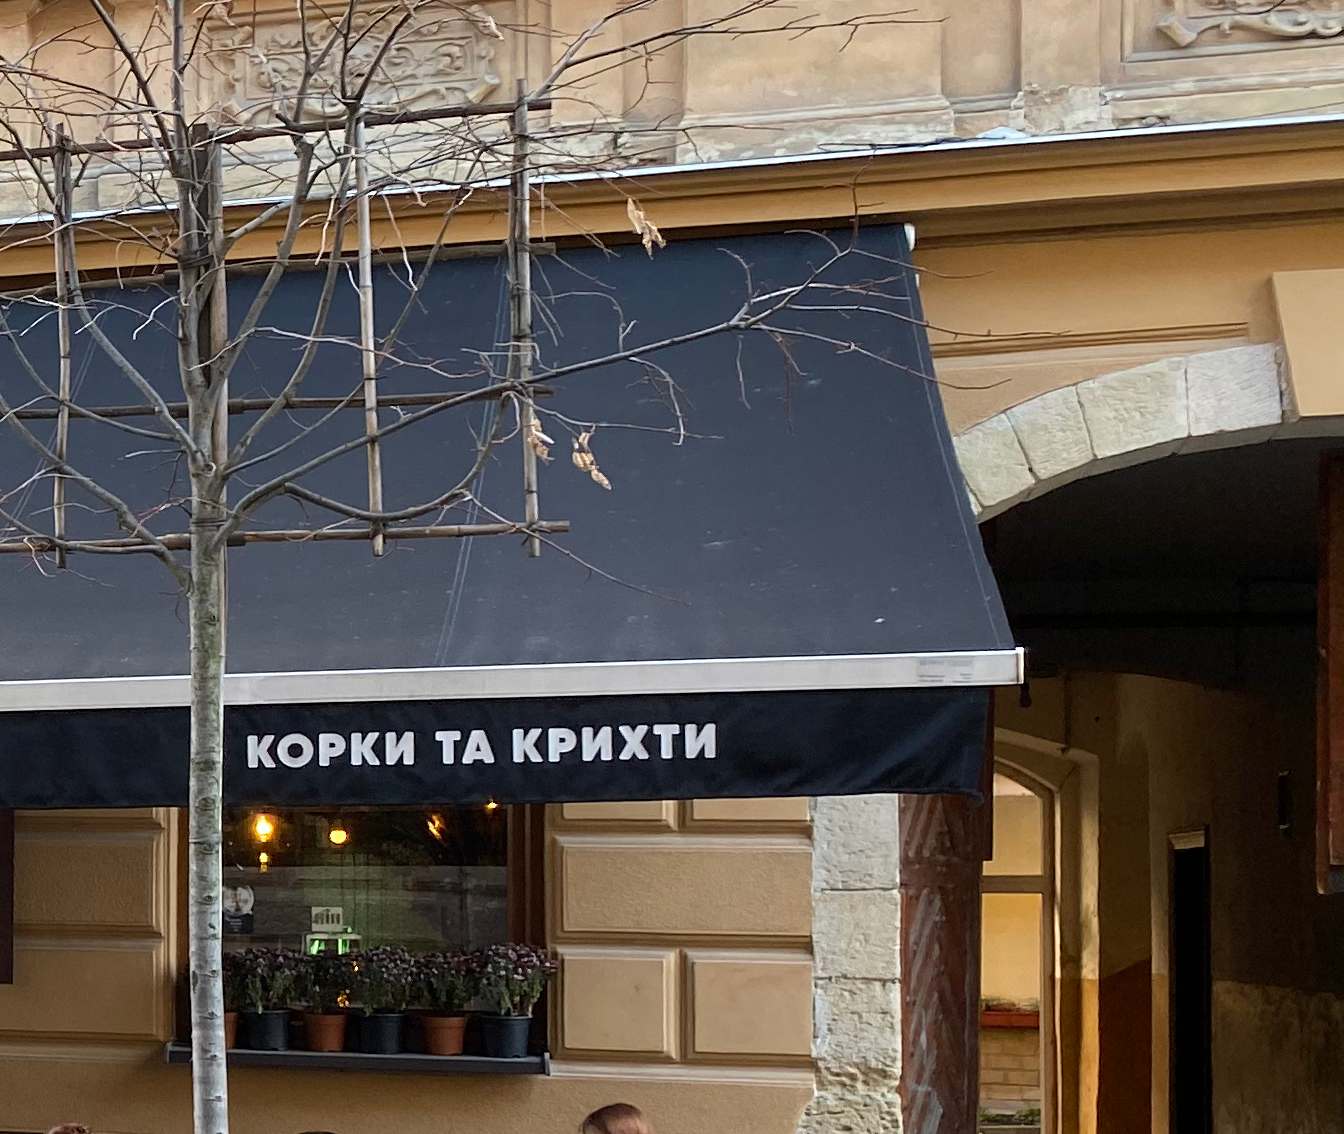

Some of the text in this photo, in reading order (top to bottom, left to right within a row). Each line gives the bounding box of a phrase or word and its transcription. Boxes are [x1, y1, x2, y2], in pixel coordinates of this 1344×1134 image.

[247, 723, 717, 768] КОРКИ ТА КРИХТИ
